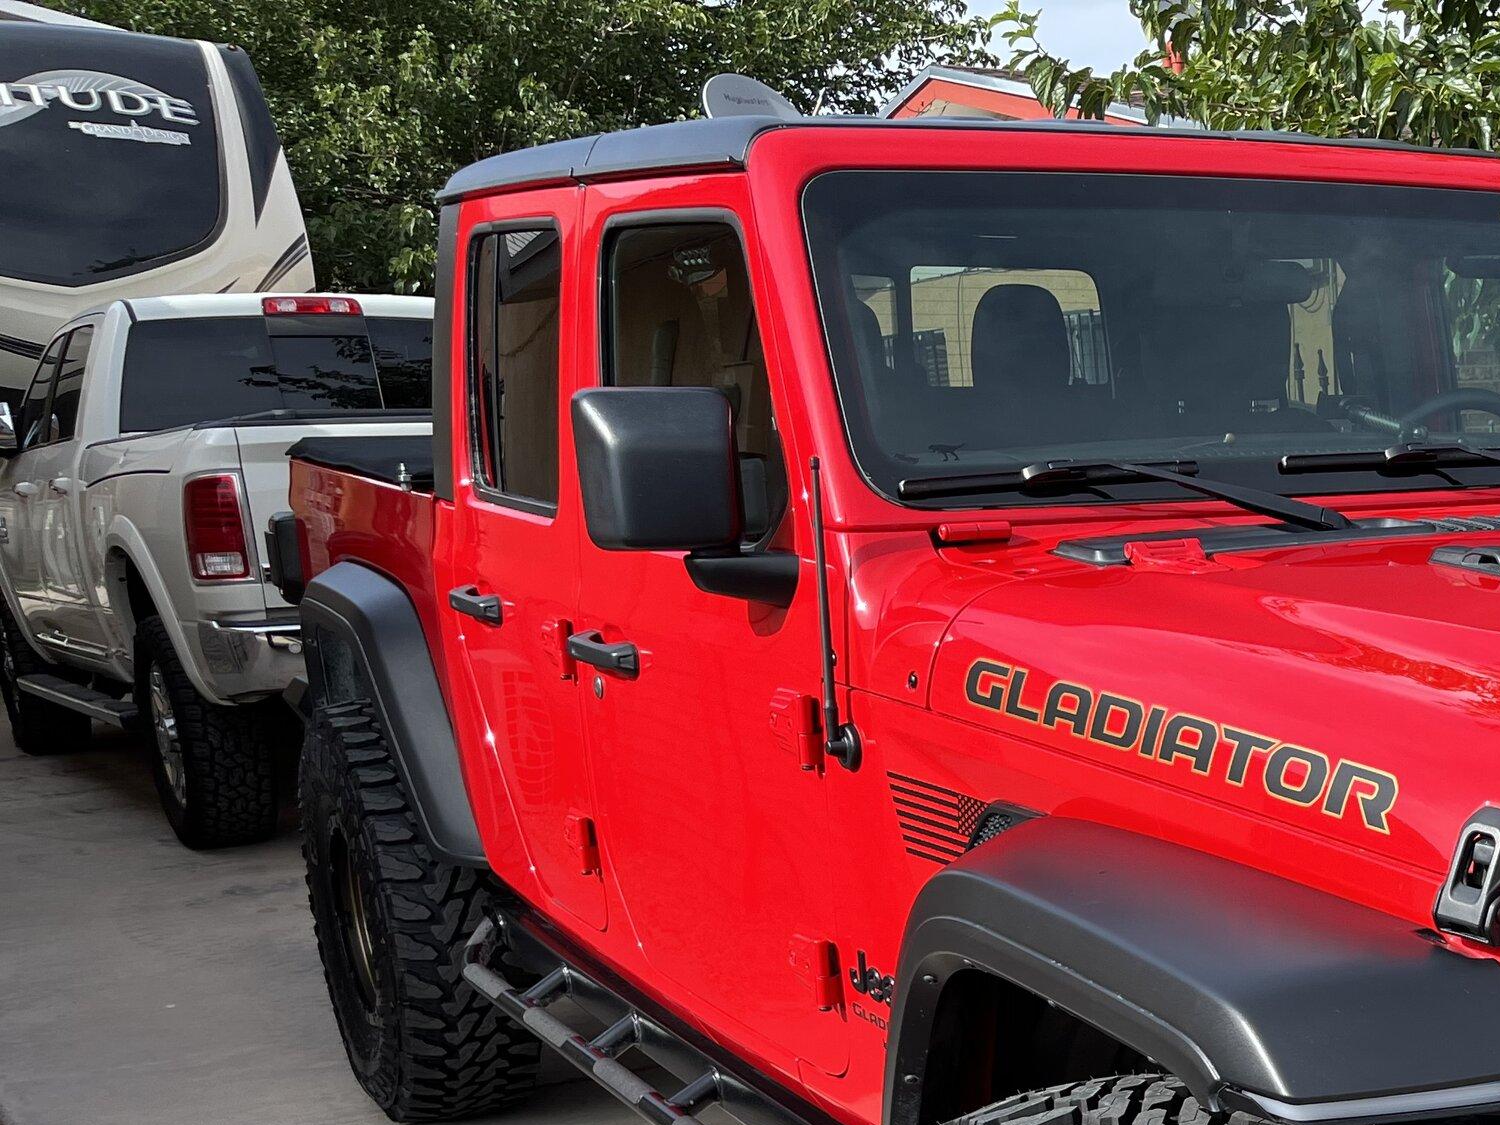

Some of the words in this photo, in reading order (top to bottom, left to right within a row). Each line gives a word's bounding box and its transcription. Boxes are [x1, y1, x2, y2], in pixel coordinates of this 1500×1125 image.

[82, 122, 131, 138] GRAND
[143, 128, 189, 145] DESIGN
[965, 657, 1398, 835] GLADIATOR
[849, 949, 895, 1008] Jee
